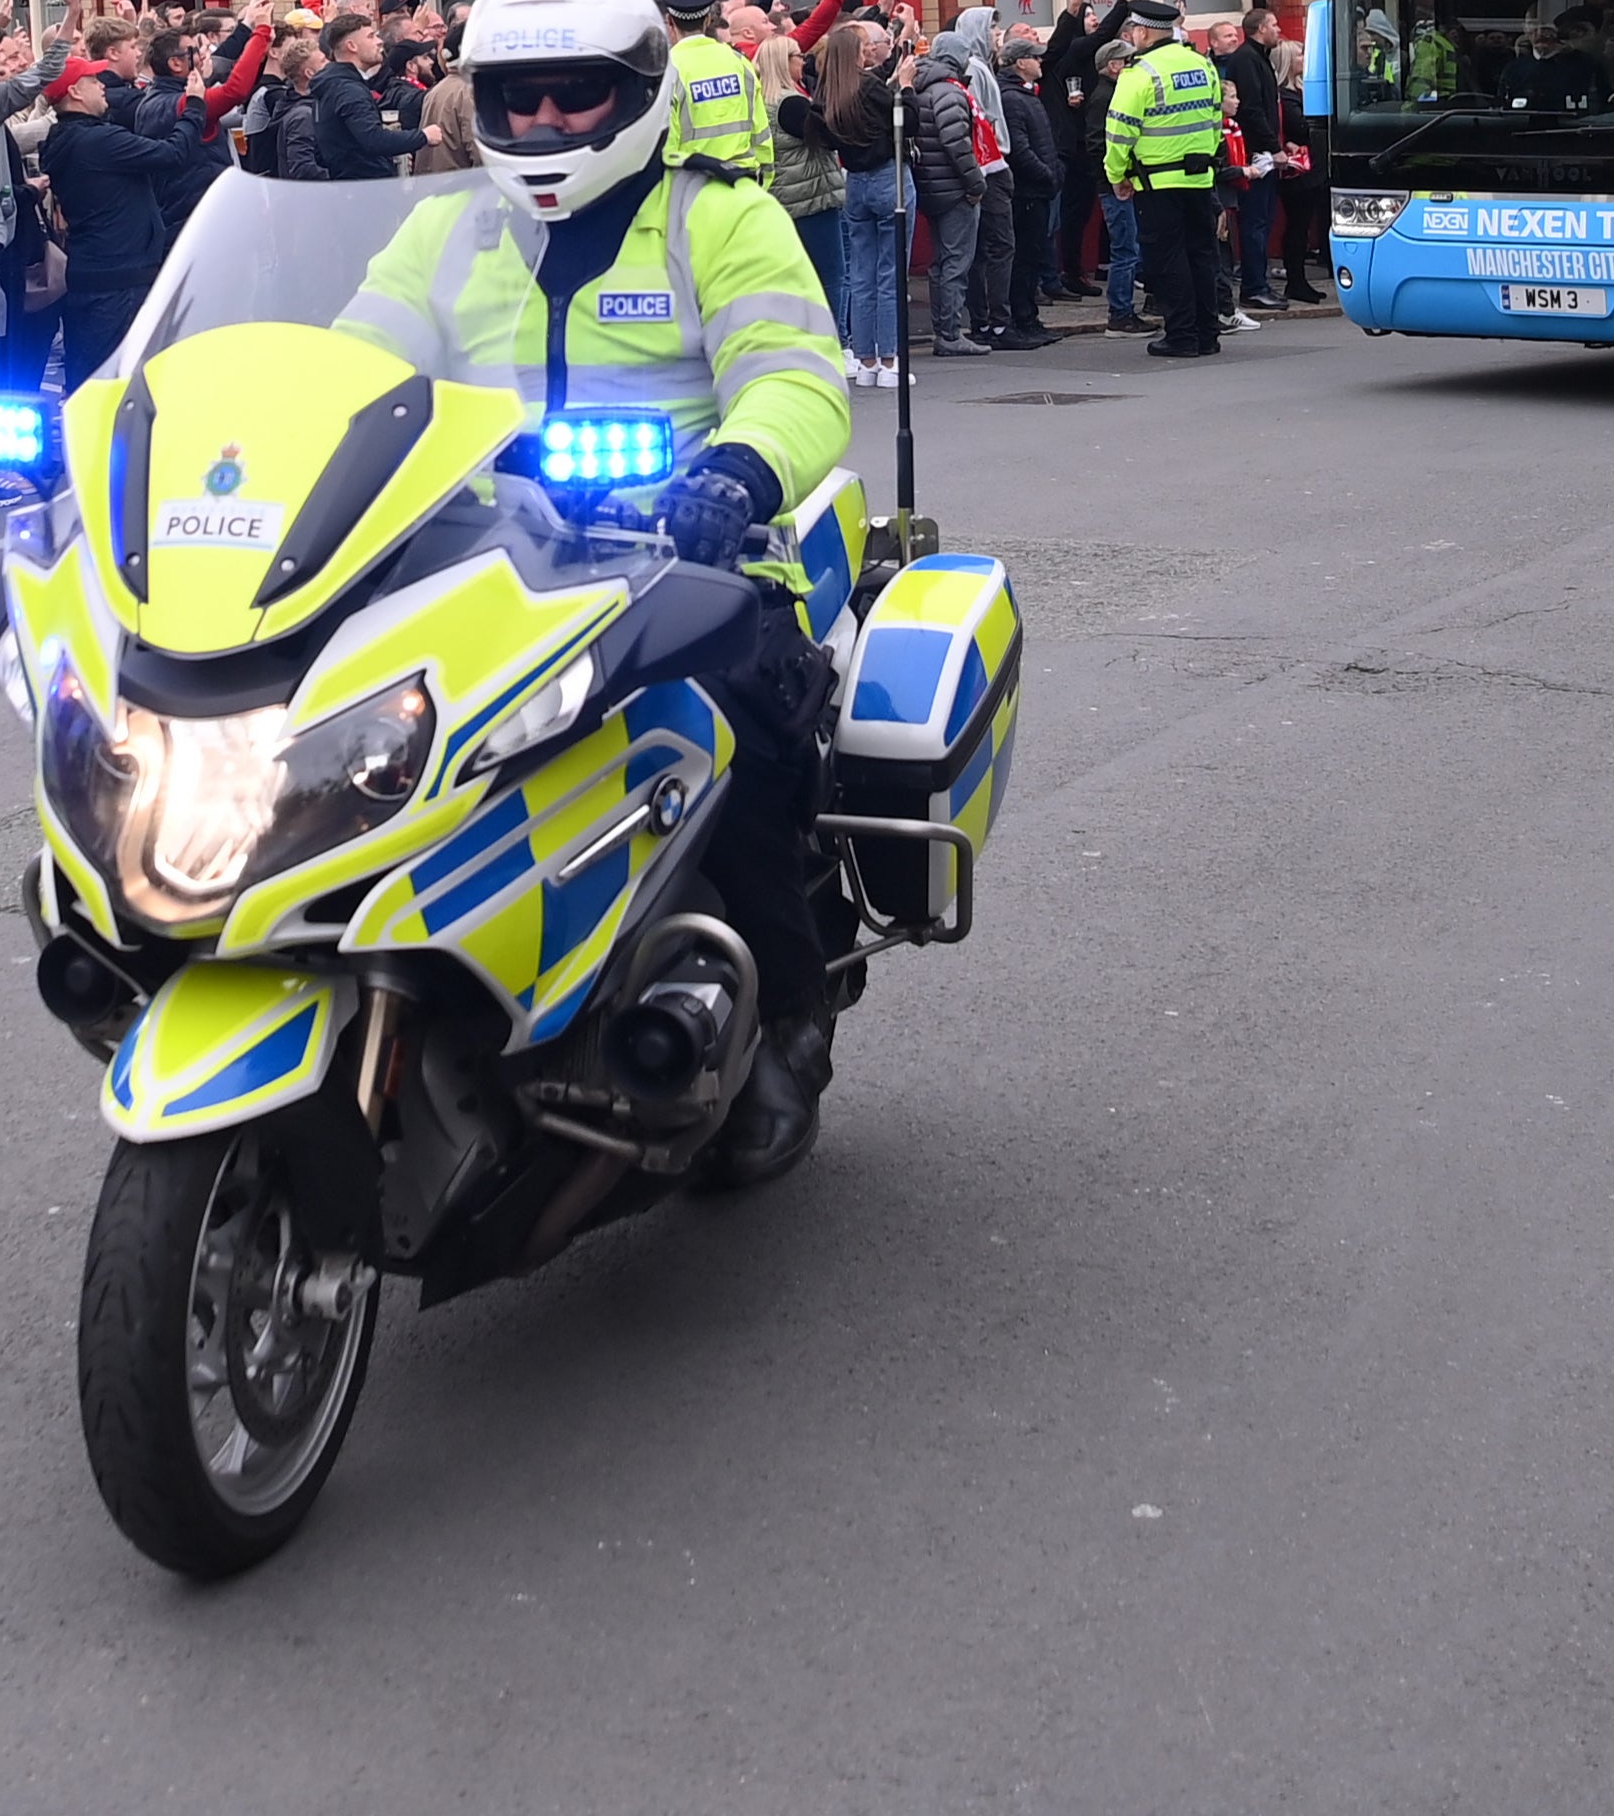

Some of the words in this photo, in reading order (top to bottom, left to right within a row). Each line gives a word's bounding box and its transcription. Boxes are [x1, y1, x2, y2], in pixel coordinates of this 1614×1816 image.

[491, 28, 575, 53] POLICE
[691, 77, 739, 100] POLICE
[1173, 71, 1206, 88] POLICE
[1423, 212, 1468, 230] NEXEN
[1477, 208, 1588, 239] NEXEN
[1466, 248, 1586, 280] MANCHESTER
[603, 296, 668, 315] POLICE
[1525, 288, 1562, 309] WSM
[1567, 290, 1579, 310] 3
[166, 515, 263, 539] POLICE
